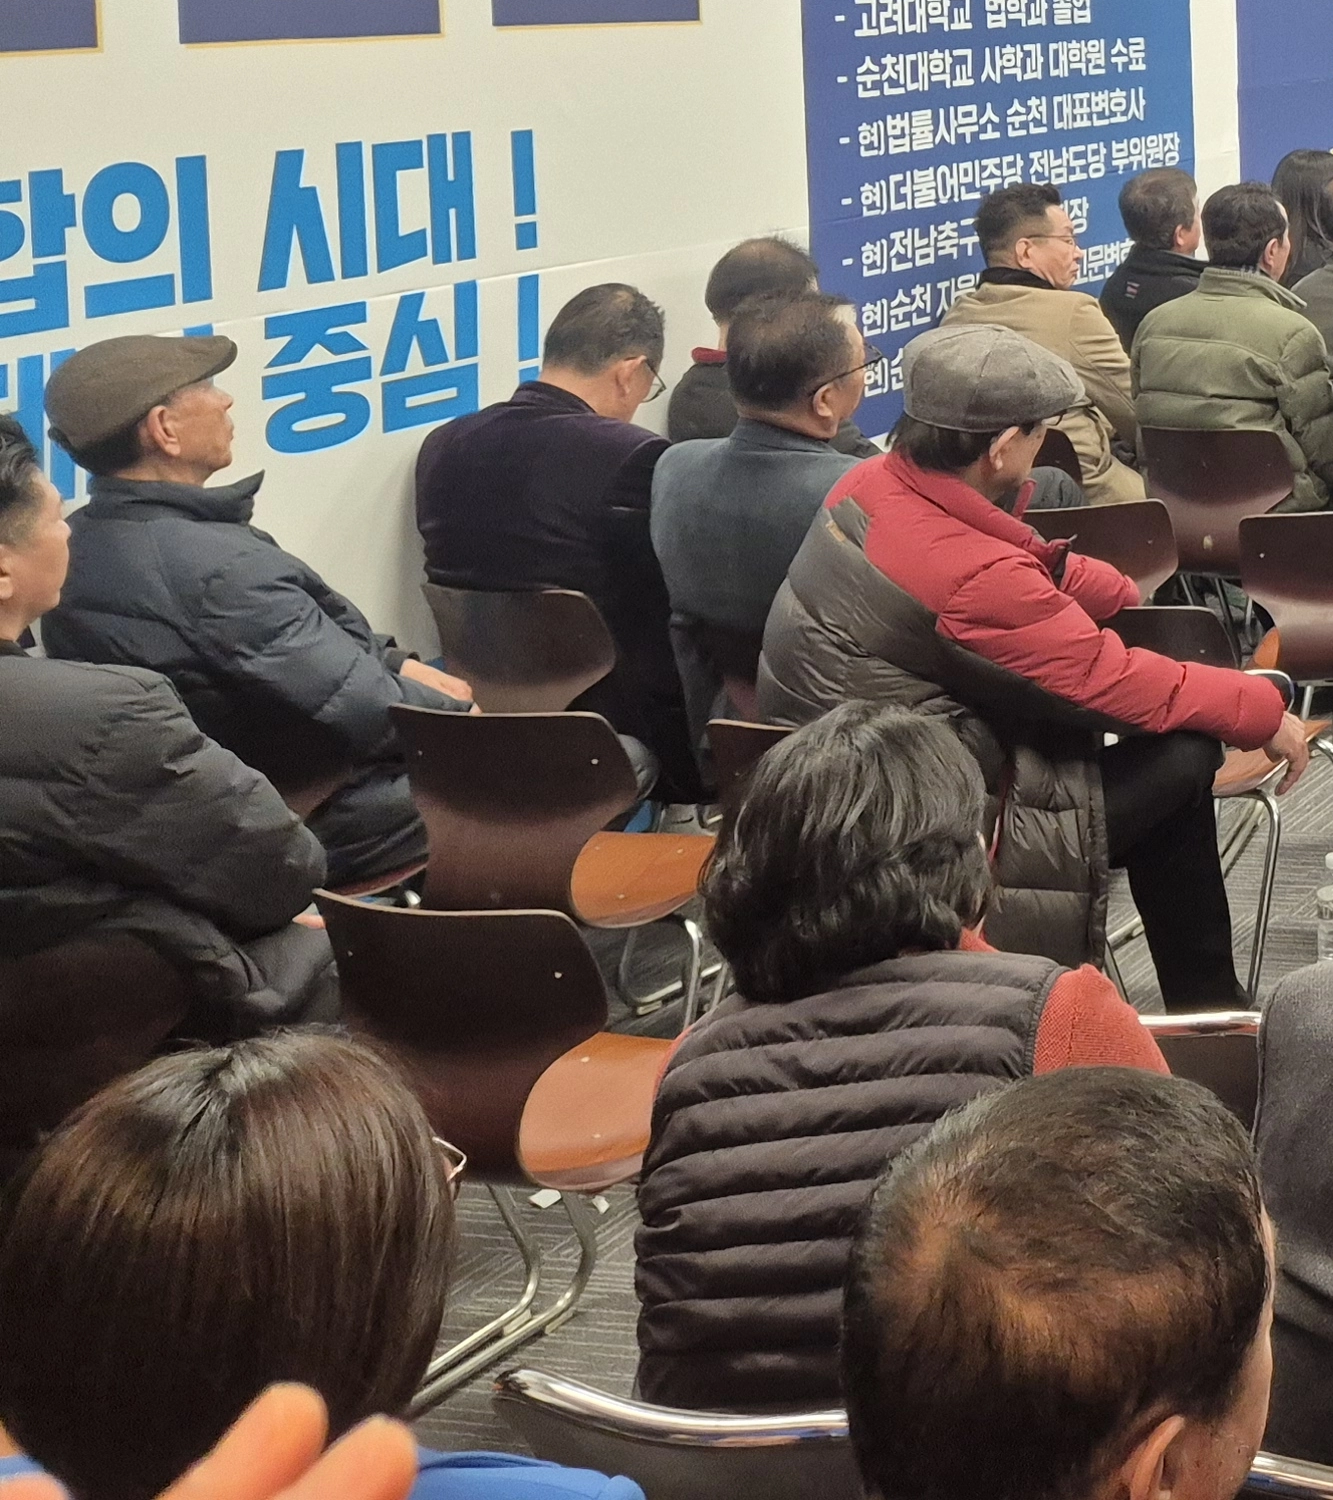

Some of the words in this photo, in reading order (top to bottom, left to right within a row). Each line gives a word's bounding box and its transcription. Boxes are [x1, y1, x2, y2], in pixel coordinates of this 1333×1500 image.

[856, 48, 975, 99] 순천대학교
[980, 42, 1044, 84] 사학과
[1049, 39, 1105, 78] 대학원
[1110, 36, 1147, 73] 수료
[1006, 95, 1048, 138] 순천
[1053, 86, 1146, 131] 대표변호사
[1029, 141, 1106, 186] 전남도당
[1111, 131, 1181, 176] 부위원장
[257, 130, 477, 292] 시대
[1060, 196, 1089, 235] 장
